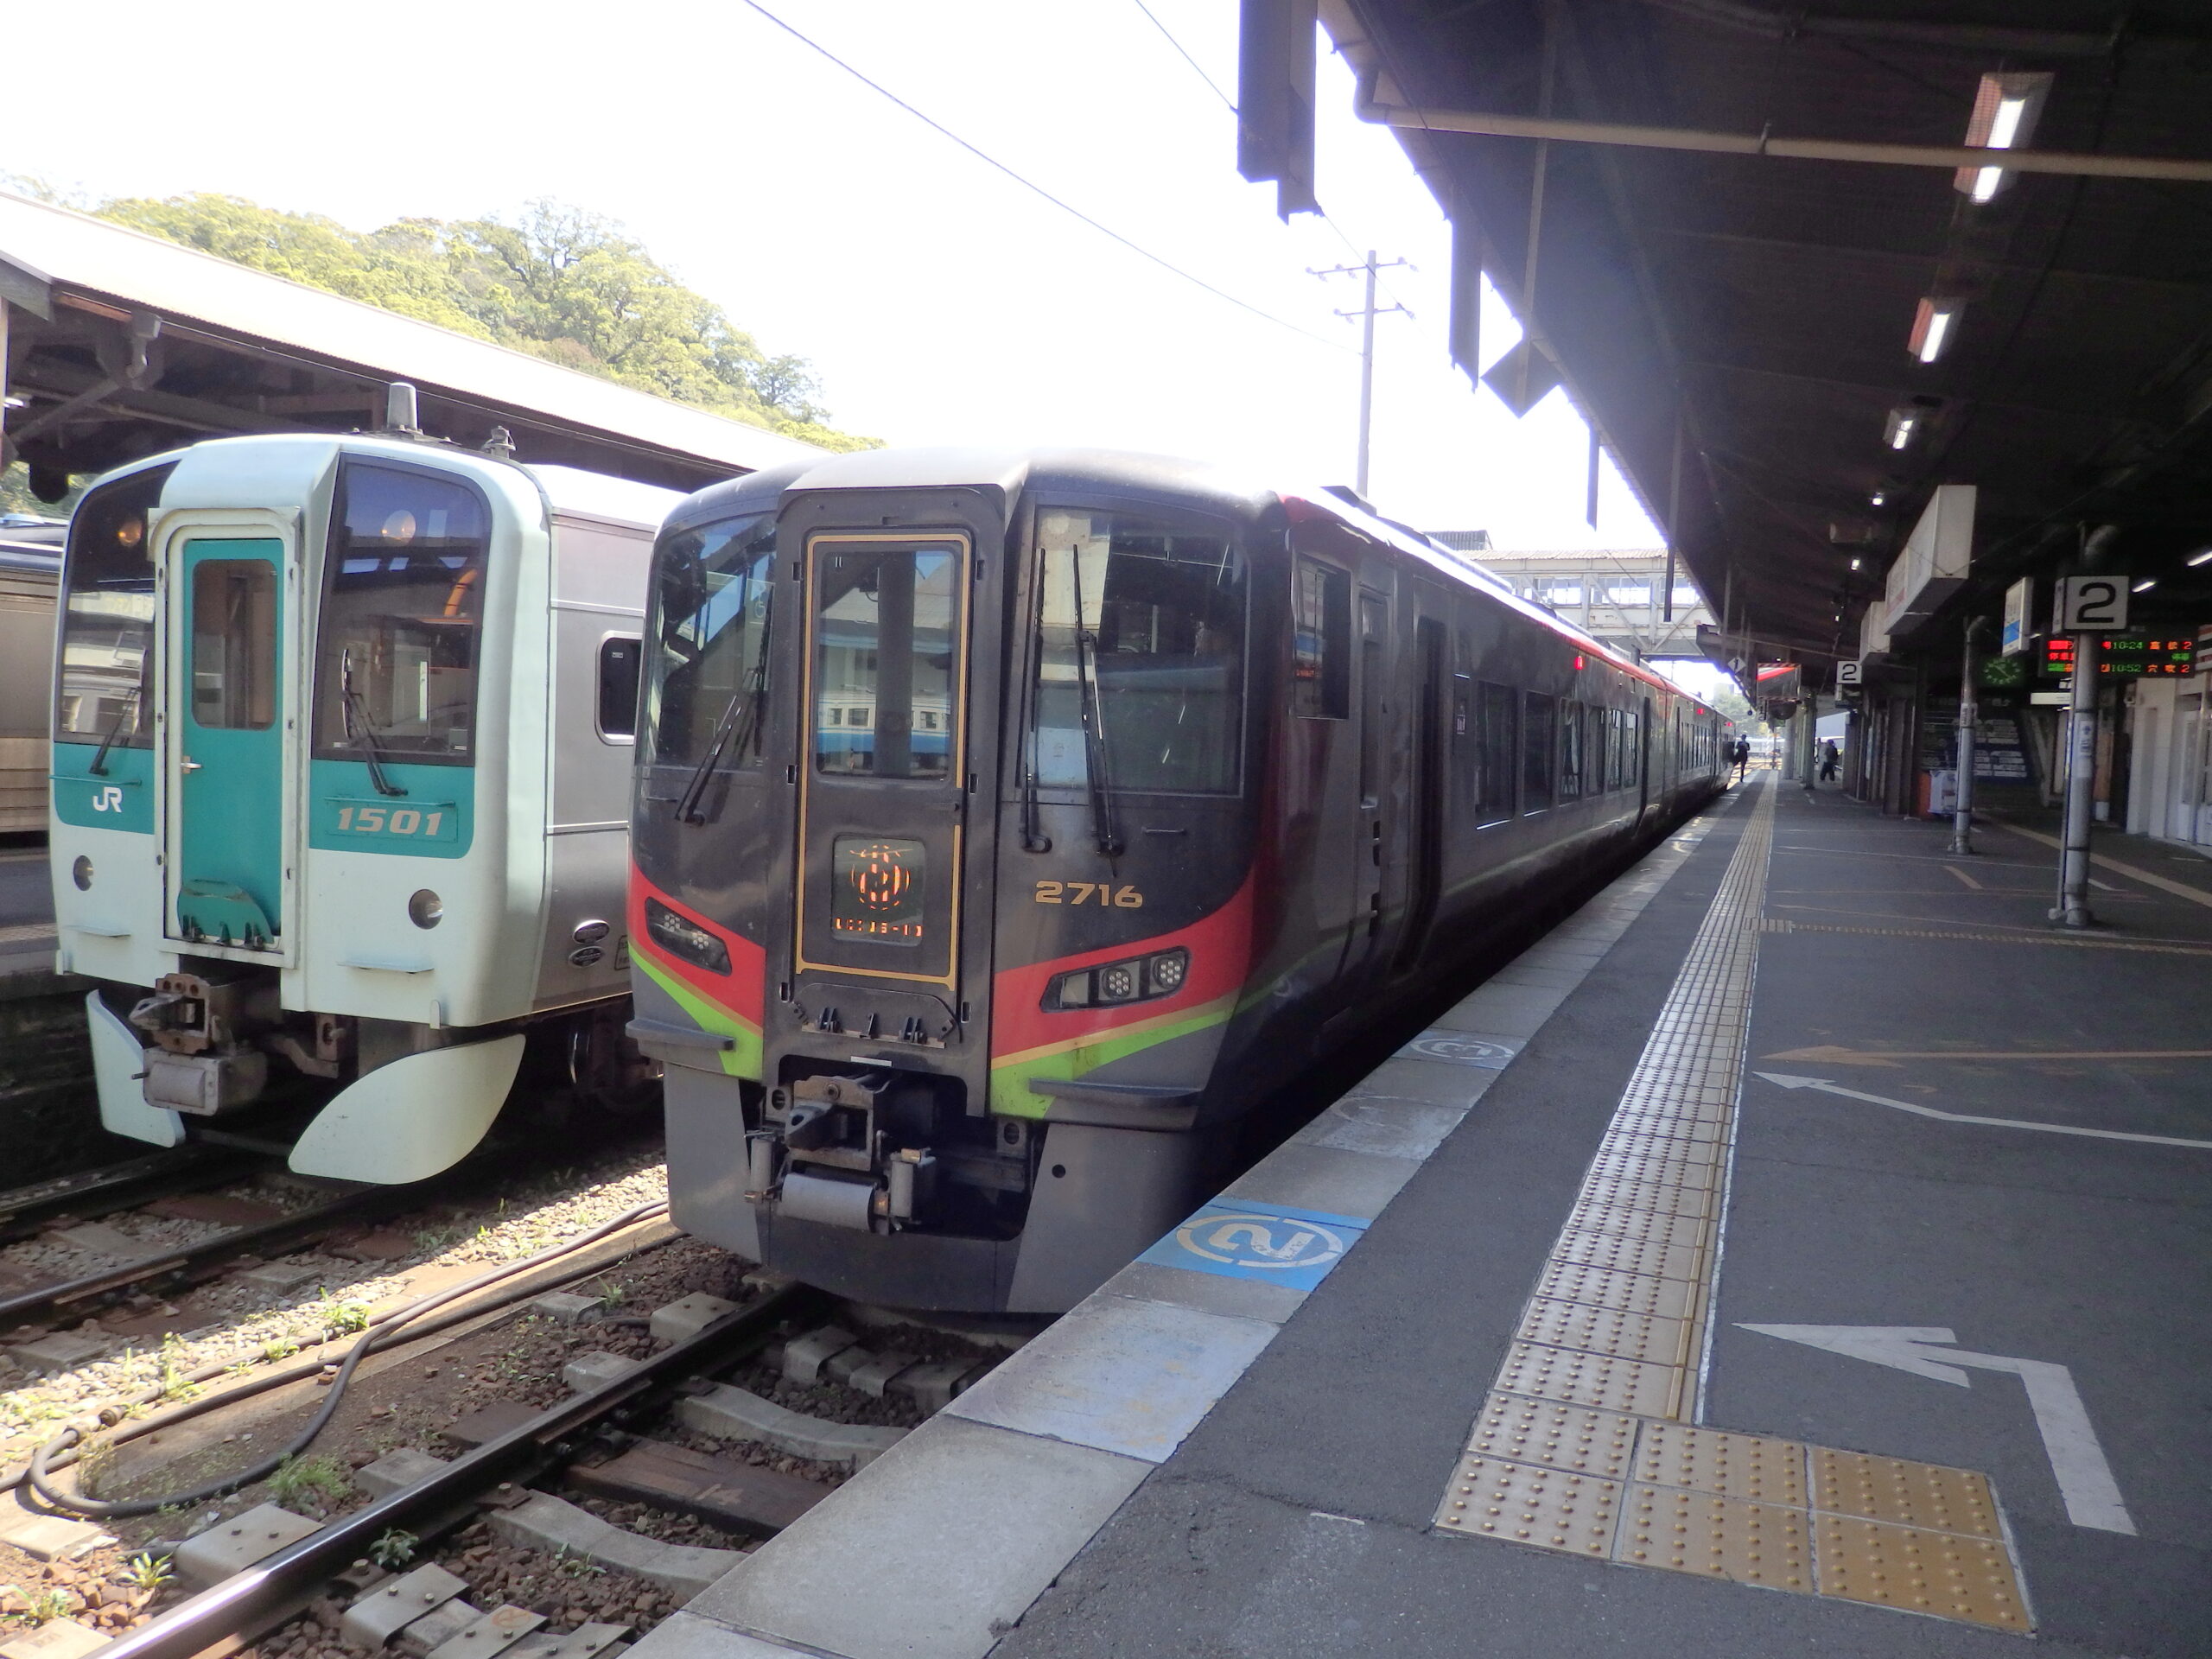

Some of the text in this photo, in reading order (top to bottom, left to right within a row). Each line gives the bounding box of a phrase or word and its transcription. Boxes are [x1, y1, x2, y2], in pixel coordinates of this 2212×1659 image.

[2076, 582, 2116, 623] 2
[2113, 641, 2143, 650] 10:24
[2183, 641, 2192, 650] 2
[1733, 658, 1739, 671] 1
[1841, 663, 1857, 681] 2
[2111, 664, 2141, 672] 10:52
[2180, 664, 2190, 673] 2
[92, 786, 122, 813] JR
[338, 807, 442, 836] 1501
[1035, 880, 1143, 908] 2716
[1210, 1223, 1315, 1260] 2
